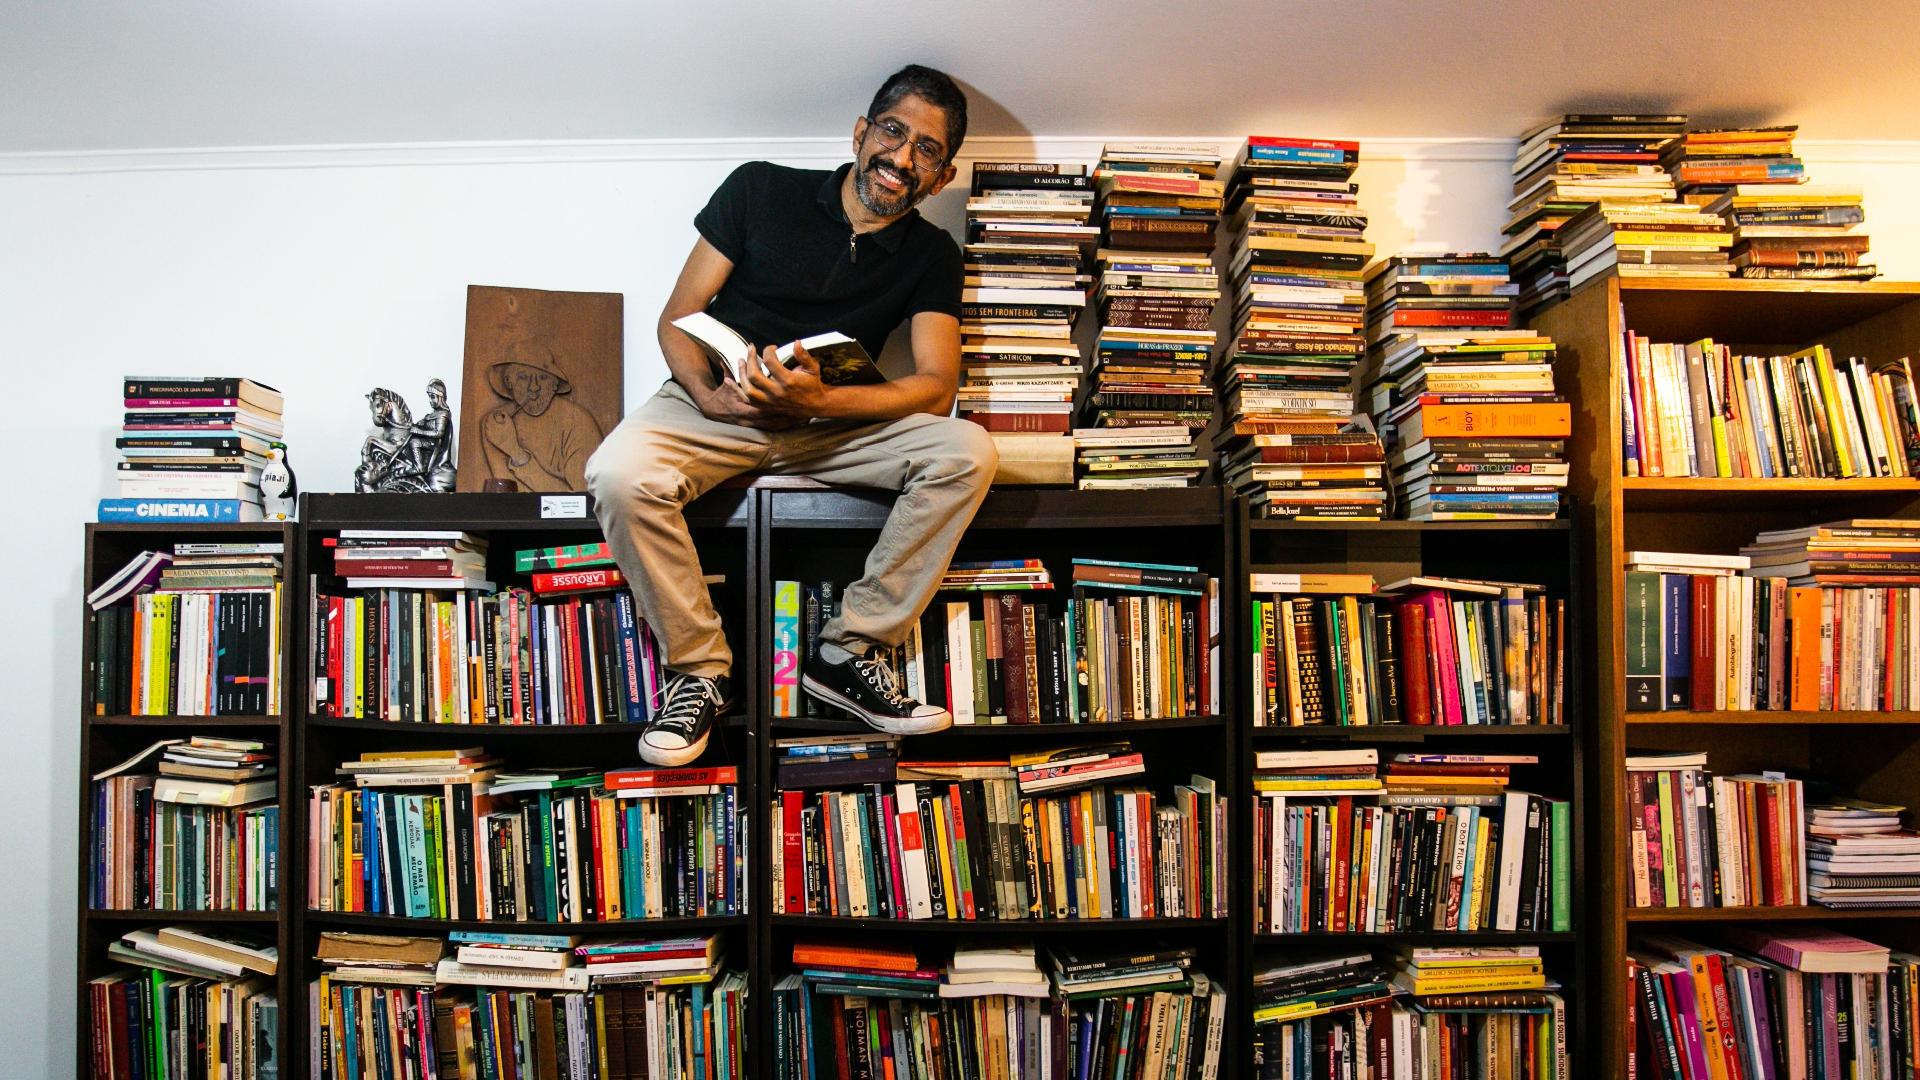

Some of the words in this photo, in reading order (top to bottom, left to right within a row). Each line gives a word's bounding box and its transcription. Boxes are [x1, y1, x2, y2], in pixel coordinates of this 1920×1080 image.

[980, 308, 992, 316] SEM
[995, 309, 1037, 317] FRONTEIRAS
[1295, 343, 1314, 351] Assis
[1326, 344, 1356, 352] Machado
[136, 503, 208, 516] CINEMA
[553, 575, 606, 588] LAROUSSE
[1264, 609, 1276, 682] SLUMBERLAND
[408, 820, 416, 848] KEROUAC
[1458, 829, 1466, 844] BOM
[410, 857, 418, 869] MEU
[1456, 846, 1465, 870] FILHO
[1637, 850, 1645, 865] vinte
[411, 870, 419, 895] IRMÃO
[1642, 972, 1653, 993] OCTAVIA
[1648, 1001, 1658, 1020] BUTLER
[1158, 1003, 1166, 1022] TODA
[855, 1011, 866, 1063] NORMAN
[1154, 1024, 1164, 1054] POESIA
